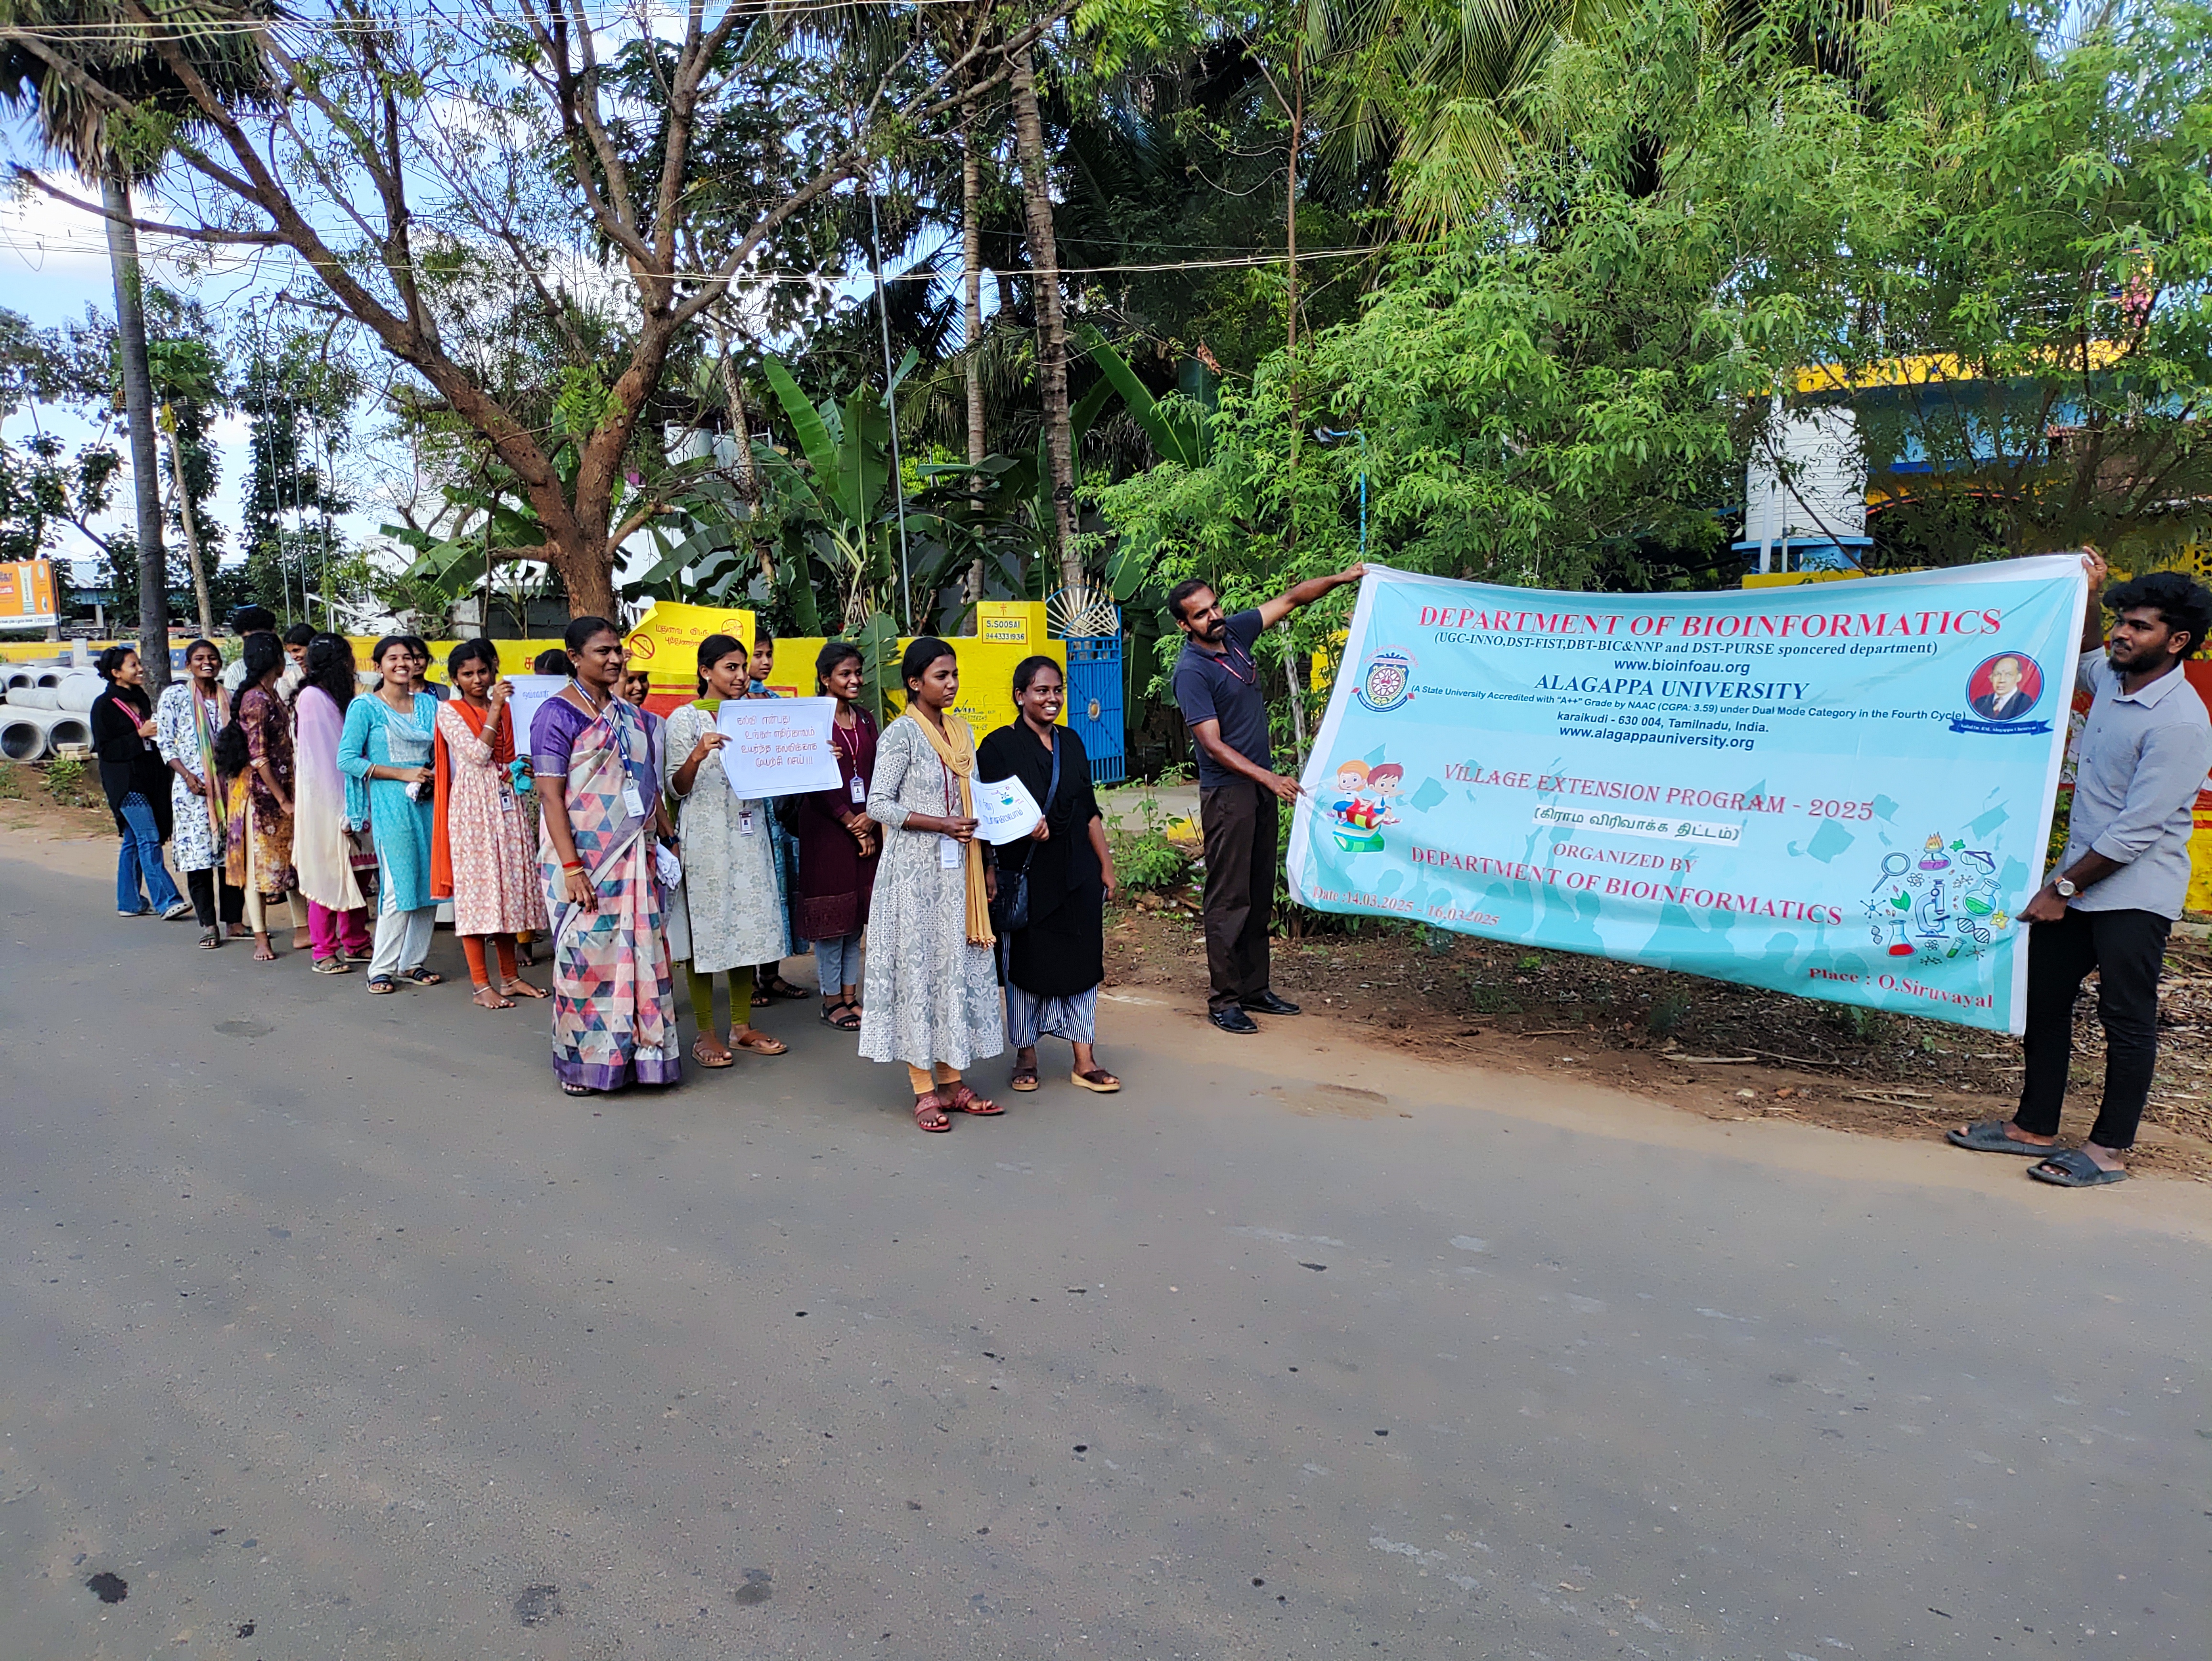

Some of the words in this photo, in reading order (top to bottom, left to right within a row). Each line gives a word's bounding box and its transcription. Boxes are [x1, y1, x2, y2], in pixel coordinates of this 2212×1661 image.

[986, 620, 1020, 629] S.SOOSAI
[1417, 606, 1624, 635] DEPARTMENT
[1630, 615, 1676, 636] OF
[1679, 609, 2002, 637] BIOINFORMATICS
[1665, 642, 1689, 653] and
[1692, 642, 1775, 655] DST-PURSE
[1778, 643, 1846, 657] sponcered
[1849, 641, 1938, 657] department)
[1614, 659, 1750, 675] www.bioinfoau.org
[1534, 674, 1654, 696] ALAGAPPA
[1661, 680, 1811, 700] UNIVERSITY
[1411, 685, 1420, 693] (A
[1422, 686, 1443, 695] State
[1445, 688, 1486, 700] University
[1487, 692, 1535, 702] Accredited
[1536, 695, 1555, 704] with
[1584, 698, 1612, 708] Grade
[1614, 700, 1626, 710] by
[1627, 701, 1656, 710] NAAC
[1658, 702, 1692, 712] (CGPA:
[1693, 704, 1718, 715] 3.59)
[1720, 705, 1749, 714] under
[1752, 706, 1775, 715] Dual
[1777, 706, 1805, 716] Mode
[1808, 708, 1857, 720] Category
[1859, 709, 1869, 718] in
[1871, 709, 1889, 719] the
[1892, 709, 1928, 720] Fourth
[1931, 710, 1967, 722] Cycle)
[1557, 711, 1608, 723] karaikudi
[1618, 716, 1638, 726] 630
[1641, 717, 1664, 729] 004,
[1669, 718, 1731, 732] Tamilnadu,
[1735, 721, 1769, 732] India.
[1559, 727, 1755, 751] www.alagappauniversity.org
[1444, 763, 1532, 788] VILLAGE
[1537, 775, 1660, 802] EXTENSION
[1666, 787, 1787, 814] PROGRAM
[1808, 798, 1874, 821] 2025
[1534, 808, 1584, 823] (கிராம
[1589, 814, 1669, 833] விரிவாக்க
[1675, 822, 1739, 841] திட்டம்)
[1552, 842, 1665, 870] ORGANIZED
[1669, 857, 1698, 874] BY
[1312, 885, 1339, 901] Date
[1411, 846, 1562, 886] DEPARTMENT
[1566, 872, 1602, 891] OF
[1605, 877, 1843, 926] BIOINFORMATICS
[1809, 967, 1859, 983] Place
[1878, 974, 1993, 1009] O.Siruvayal
